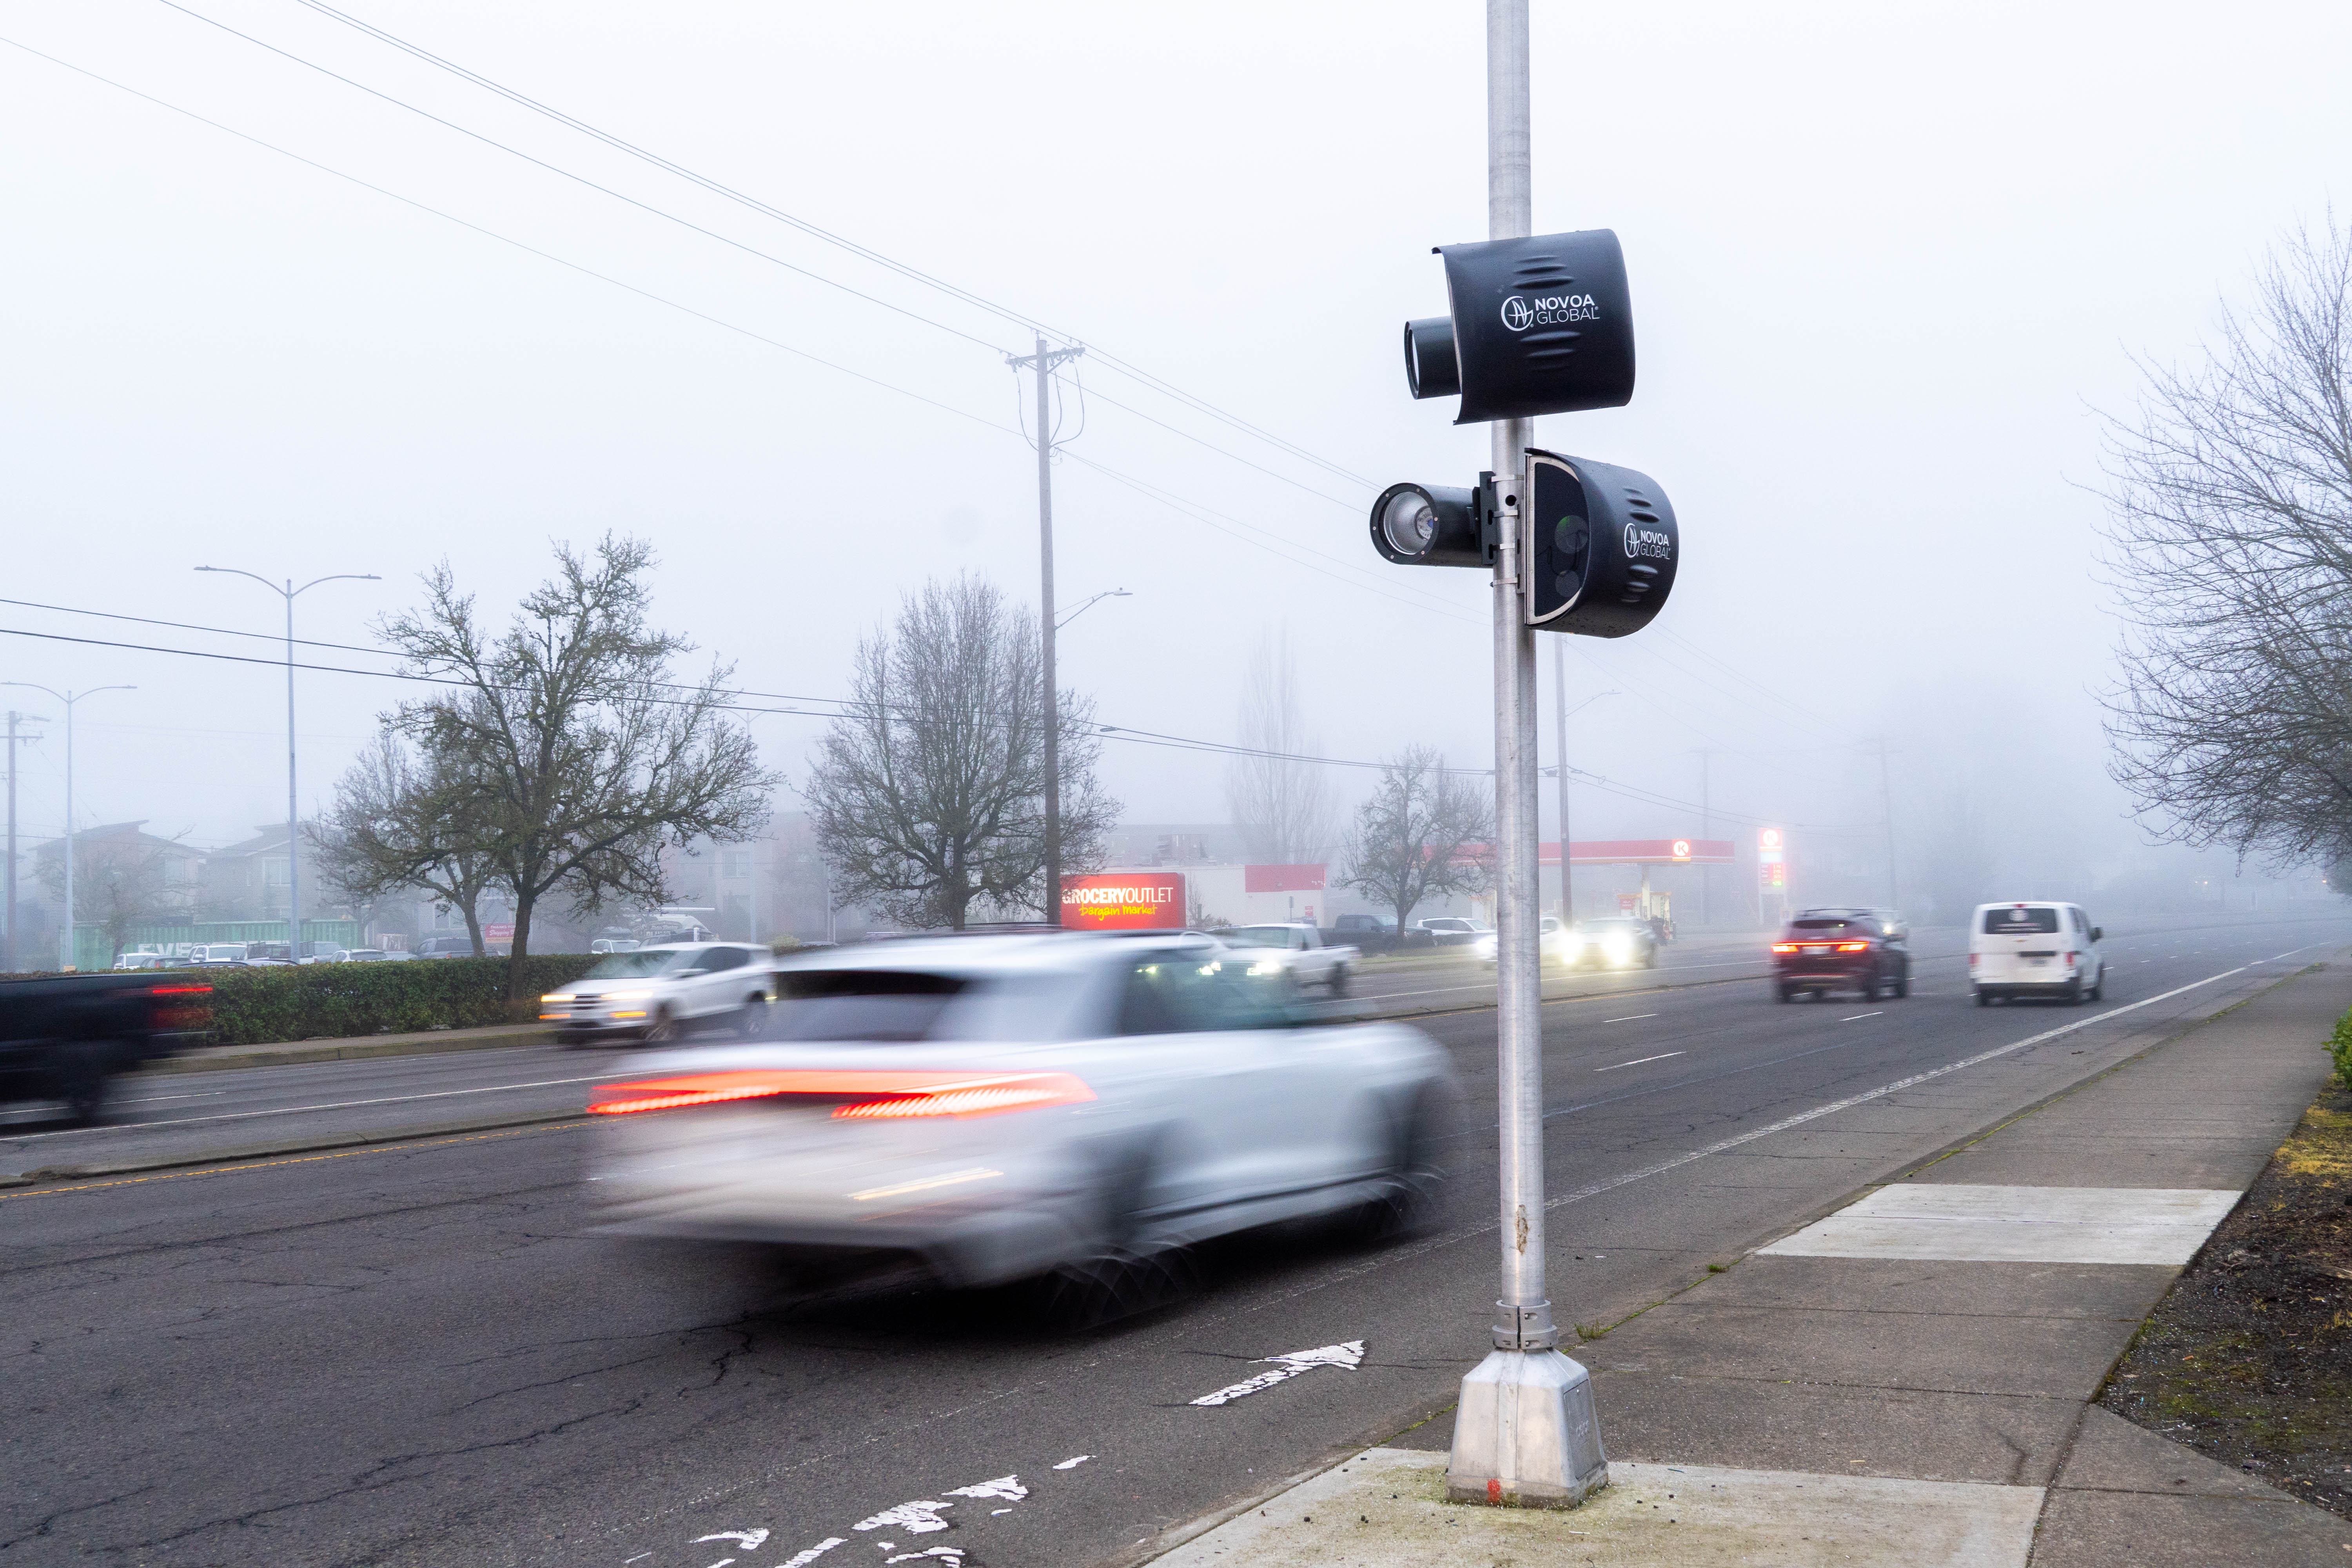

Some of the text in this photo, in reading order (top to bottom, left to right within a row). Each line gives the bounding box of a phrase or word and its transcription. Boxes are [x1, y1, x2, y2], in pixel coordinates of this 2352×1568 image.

[1535, 294, 1595, 311] NOVOA
[1641, 530, 1669, 546] NOVOA
[1641, 543, 1670, 560] GLOBAL
